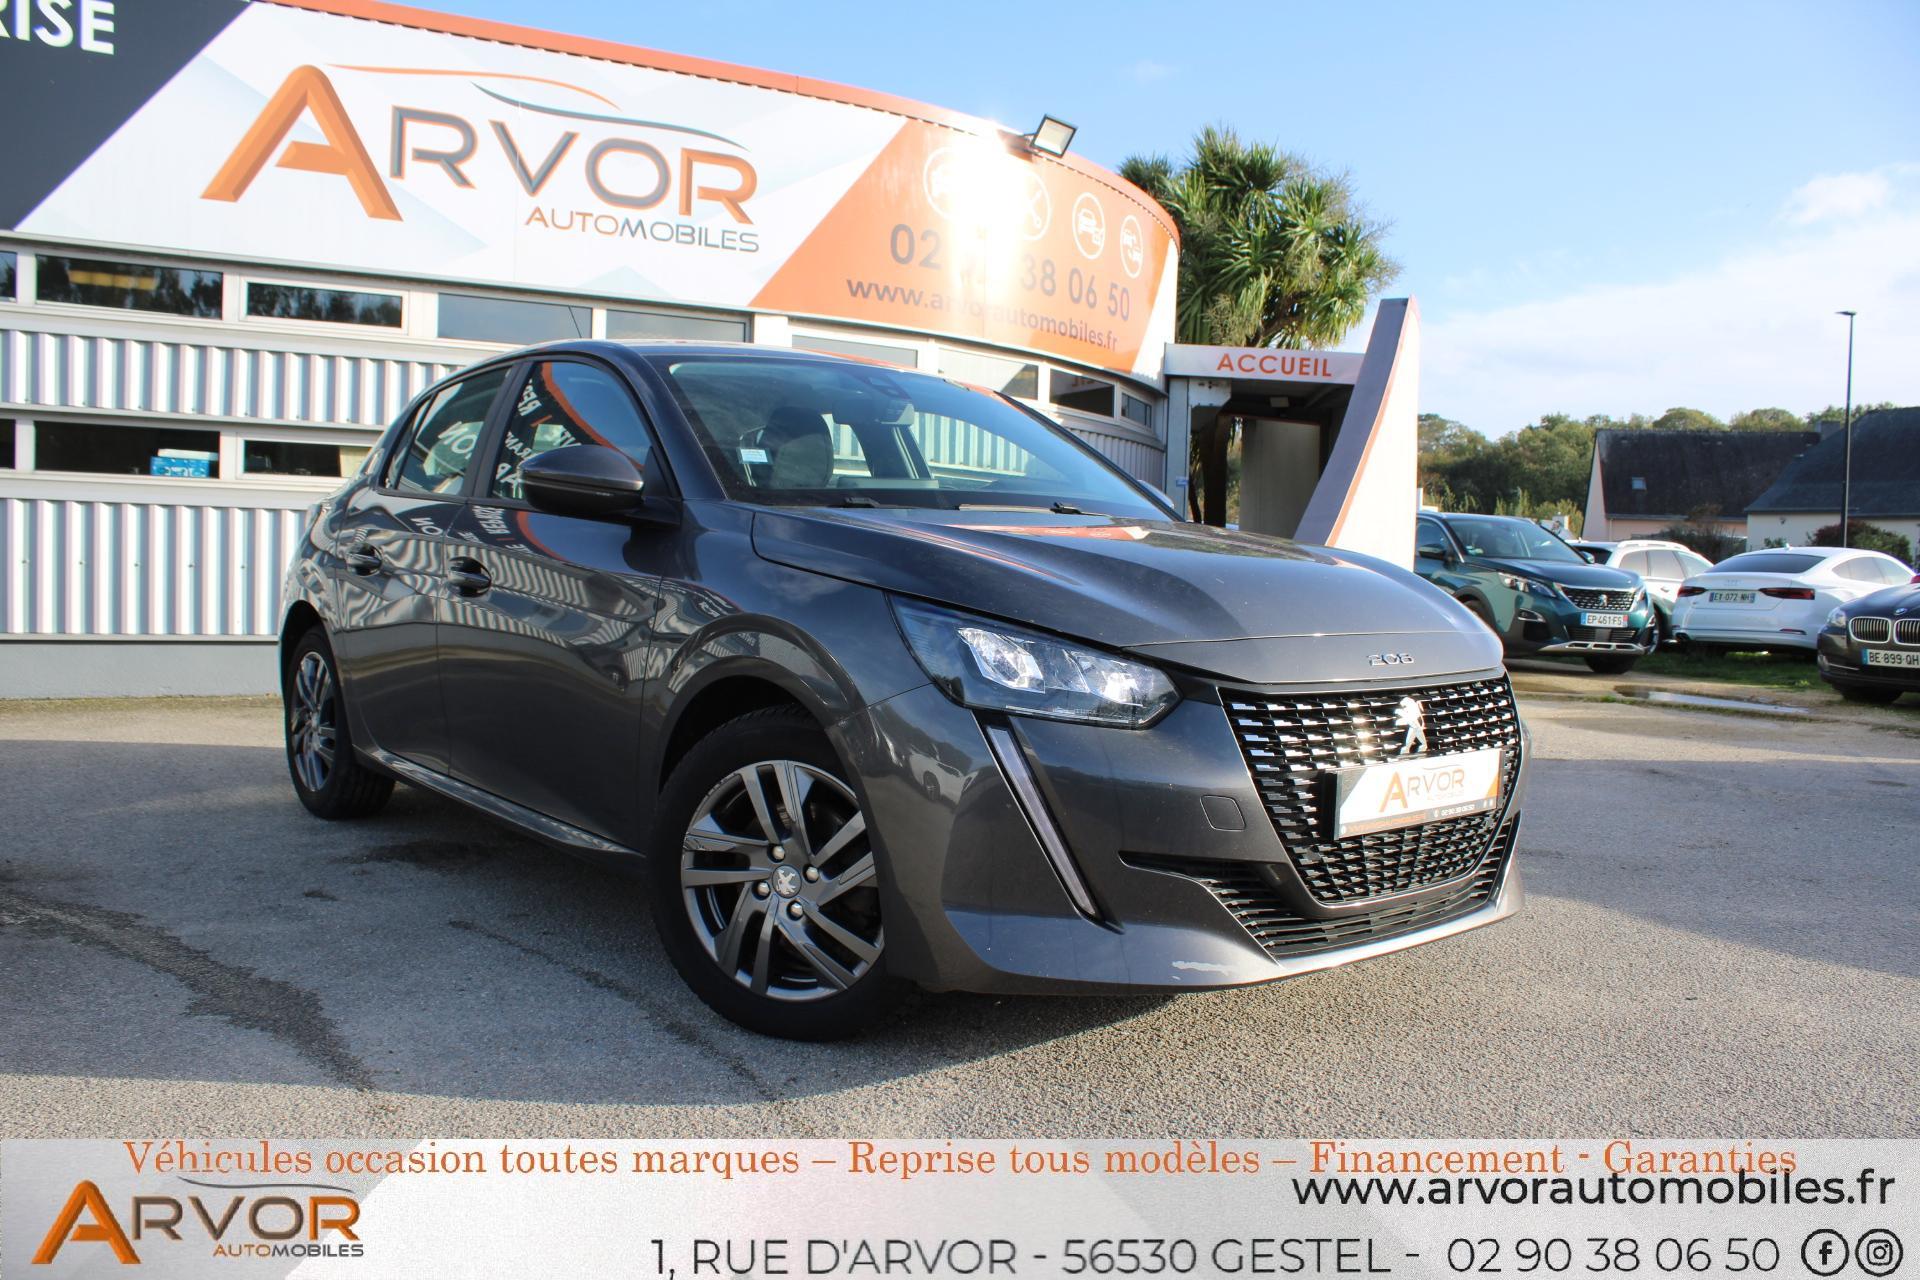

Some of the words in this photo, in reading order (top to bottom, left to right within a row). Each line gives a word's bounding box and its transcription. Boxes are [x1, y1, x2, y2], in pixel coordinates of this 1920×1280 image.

[0, 0, 115, 55] ISE
[199, 64, 758, 225] ARVOR
[525, 205, 760, 253] AUTOMOBILES
[889, 223, 942, 271] 02
[1021, 253, 1057, 297] 38
[1068, 267, 1098, 309] 06
[1107, 281, 1131, 322] 50
[1216, 352, 1332, 377] ACCUEIL
[1378, 768, 1466, 814] ARVOR
